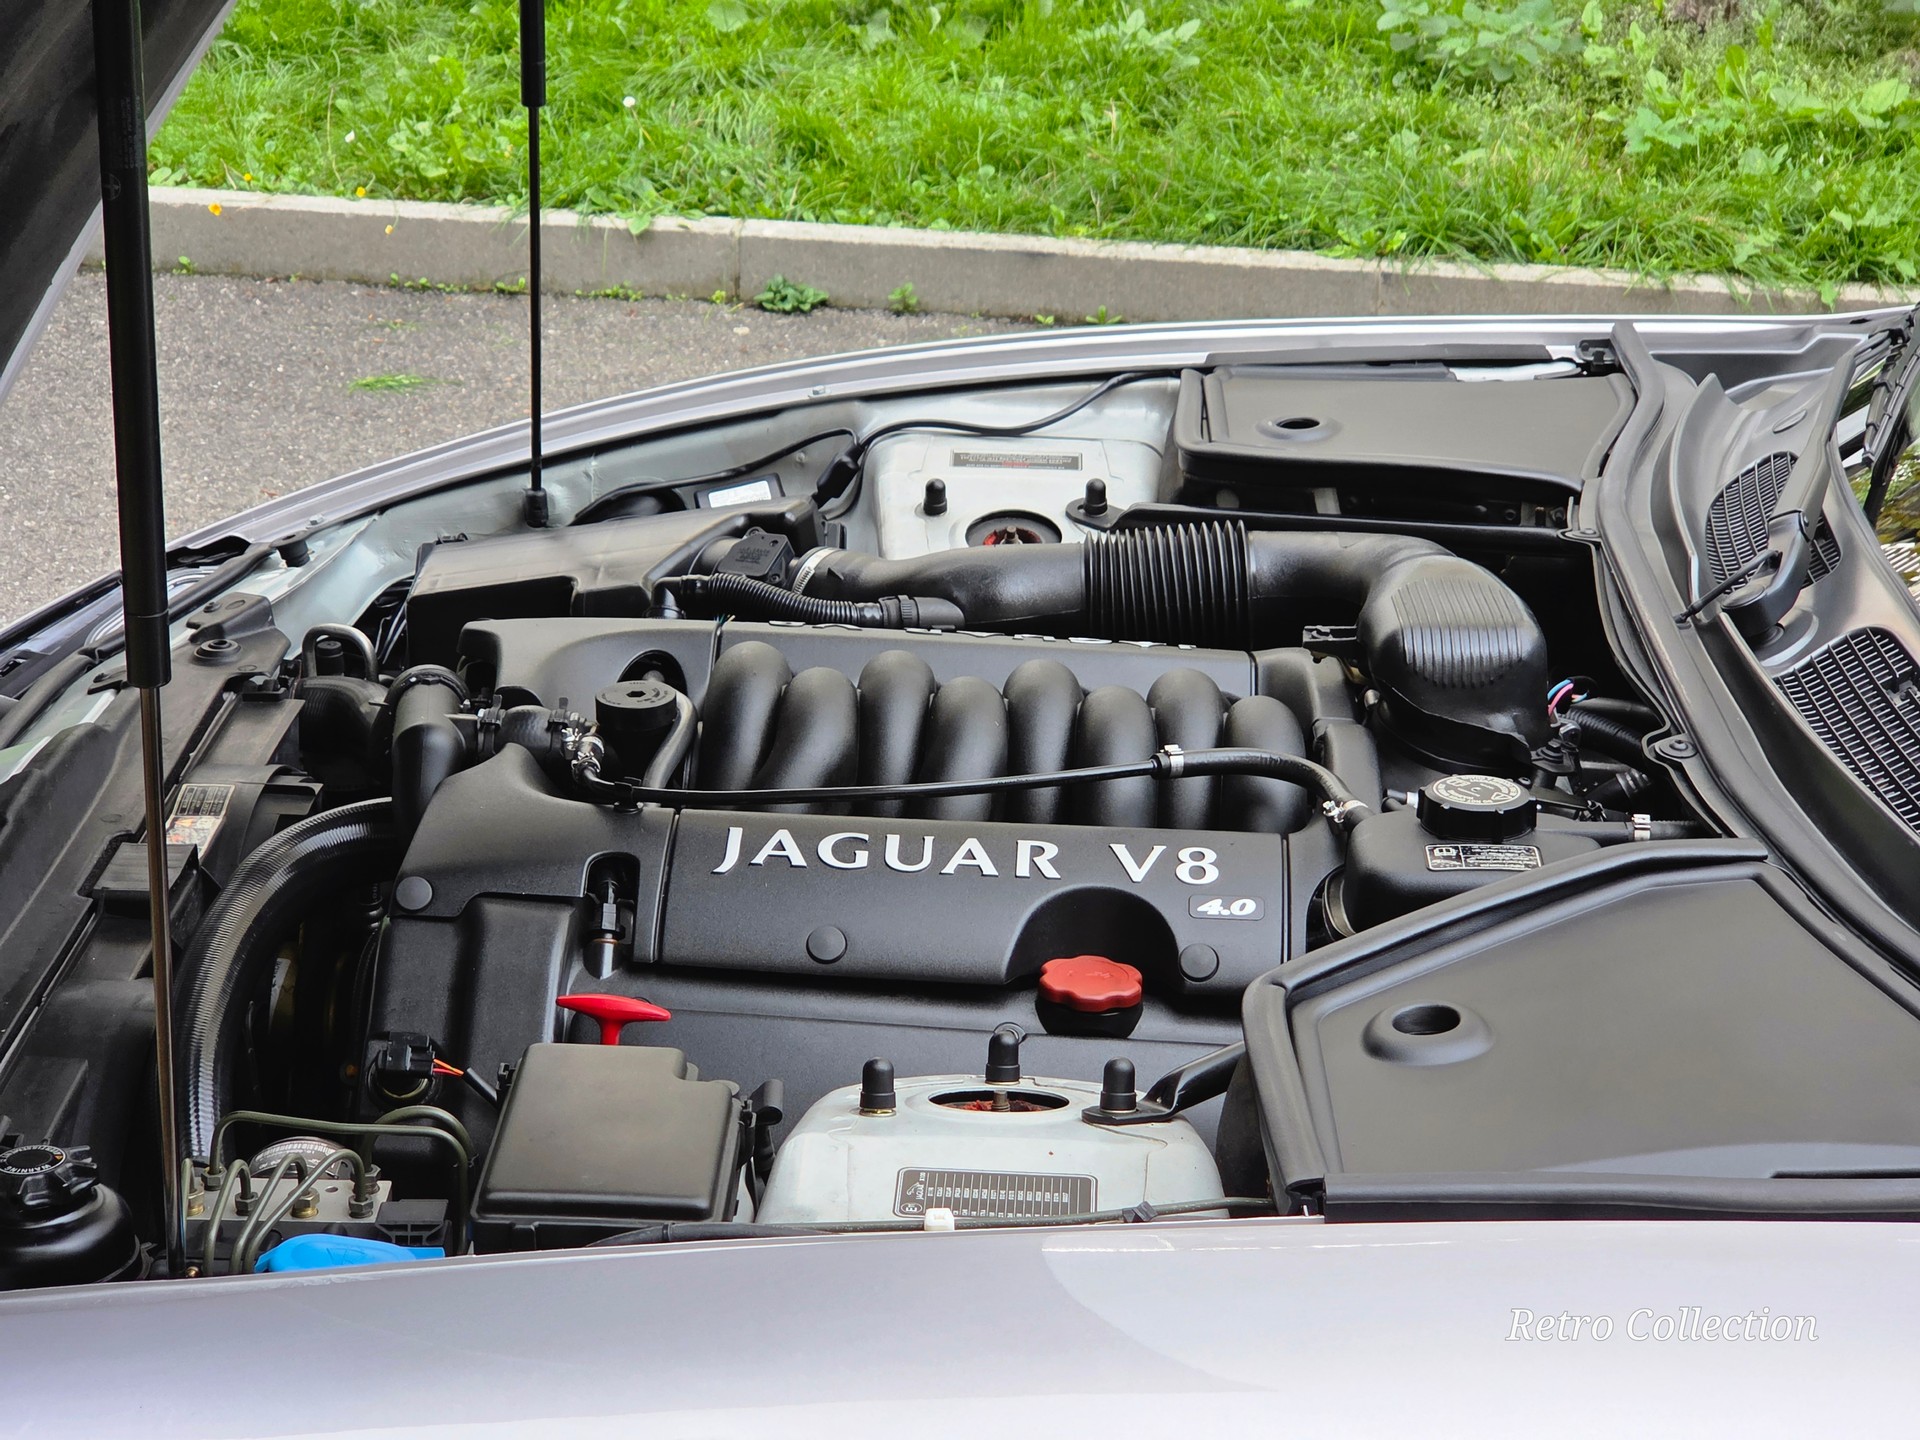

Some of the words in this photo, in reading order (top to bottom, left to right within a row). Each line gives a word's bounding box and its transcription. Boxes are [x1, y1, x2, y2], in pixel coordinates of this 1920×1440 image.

[712, 826, 1061, 880] JAGUAR
[1109, 842, 1219, 886] V8
[1196, 898, 1257, 917] 4.0
[4, 1164, 52, 1173] WARNING
